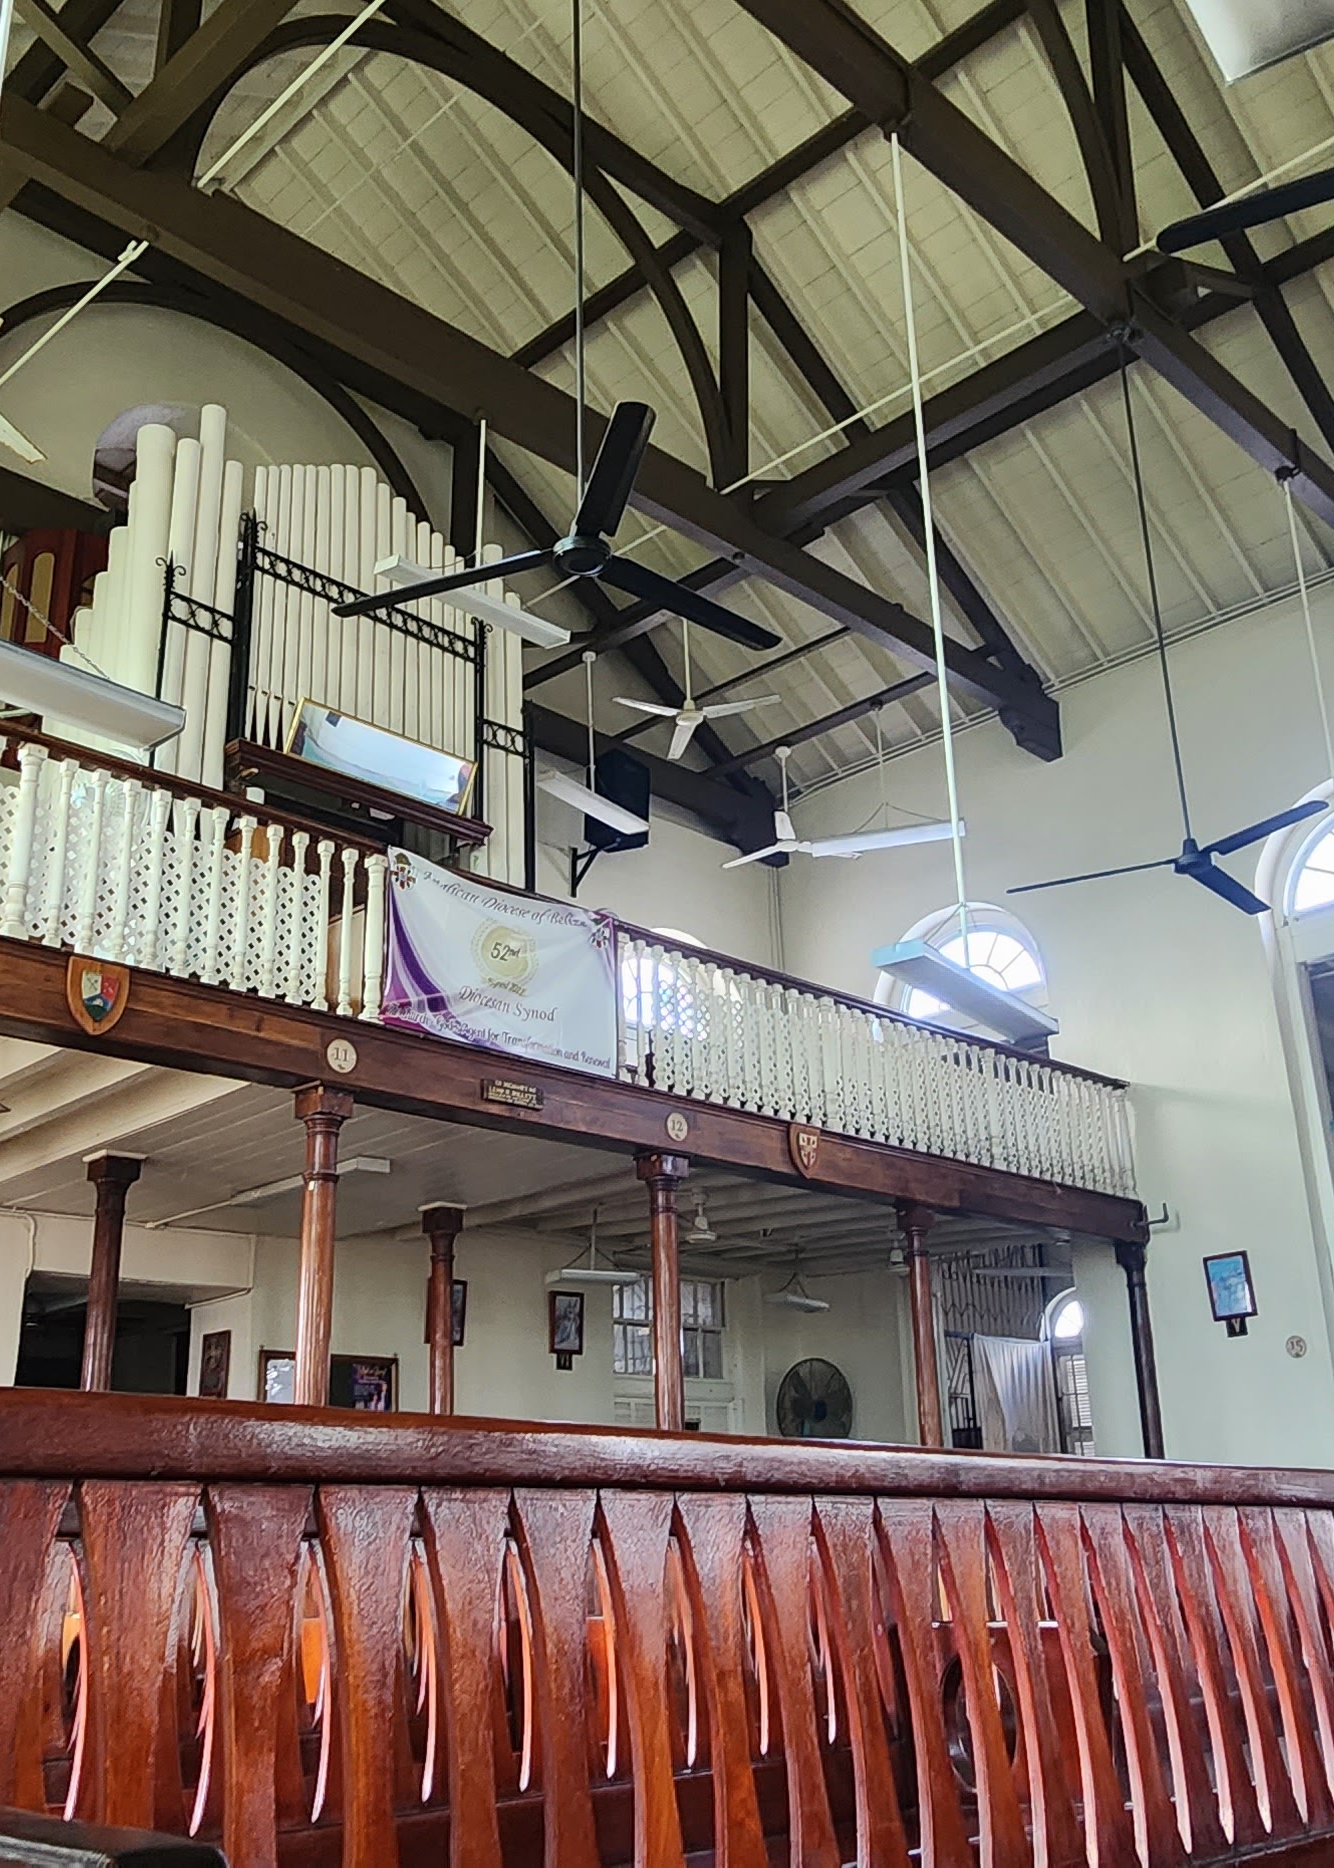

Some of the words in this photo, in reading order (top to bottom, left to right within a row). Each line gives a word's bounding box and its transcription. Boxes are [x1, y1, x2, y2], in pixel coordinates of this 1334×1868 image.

[481, 896, 531, 919] Diocese
[531, 908, 549, 926] of
[548, 911, 588, 928] Belize
[490, 942, 520, 961] 52nd
[459, 985, 510, 1014] Diocesan
[513, 1001, 558, 1022] Synod
[486, 1028, 500, 1042] for
[334, 1047, 348, 1062] 11
[671, 1119, 684, 1133] 12
[1231, 1317, 1241, 1333] V
[1290, 1340, 1304, 1352] 15
